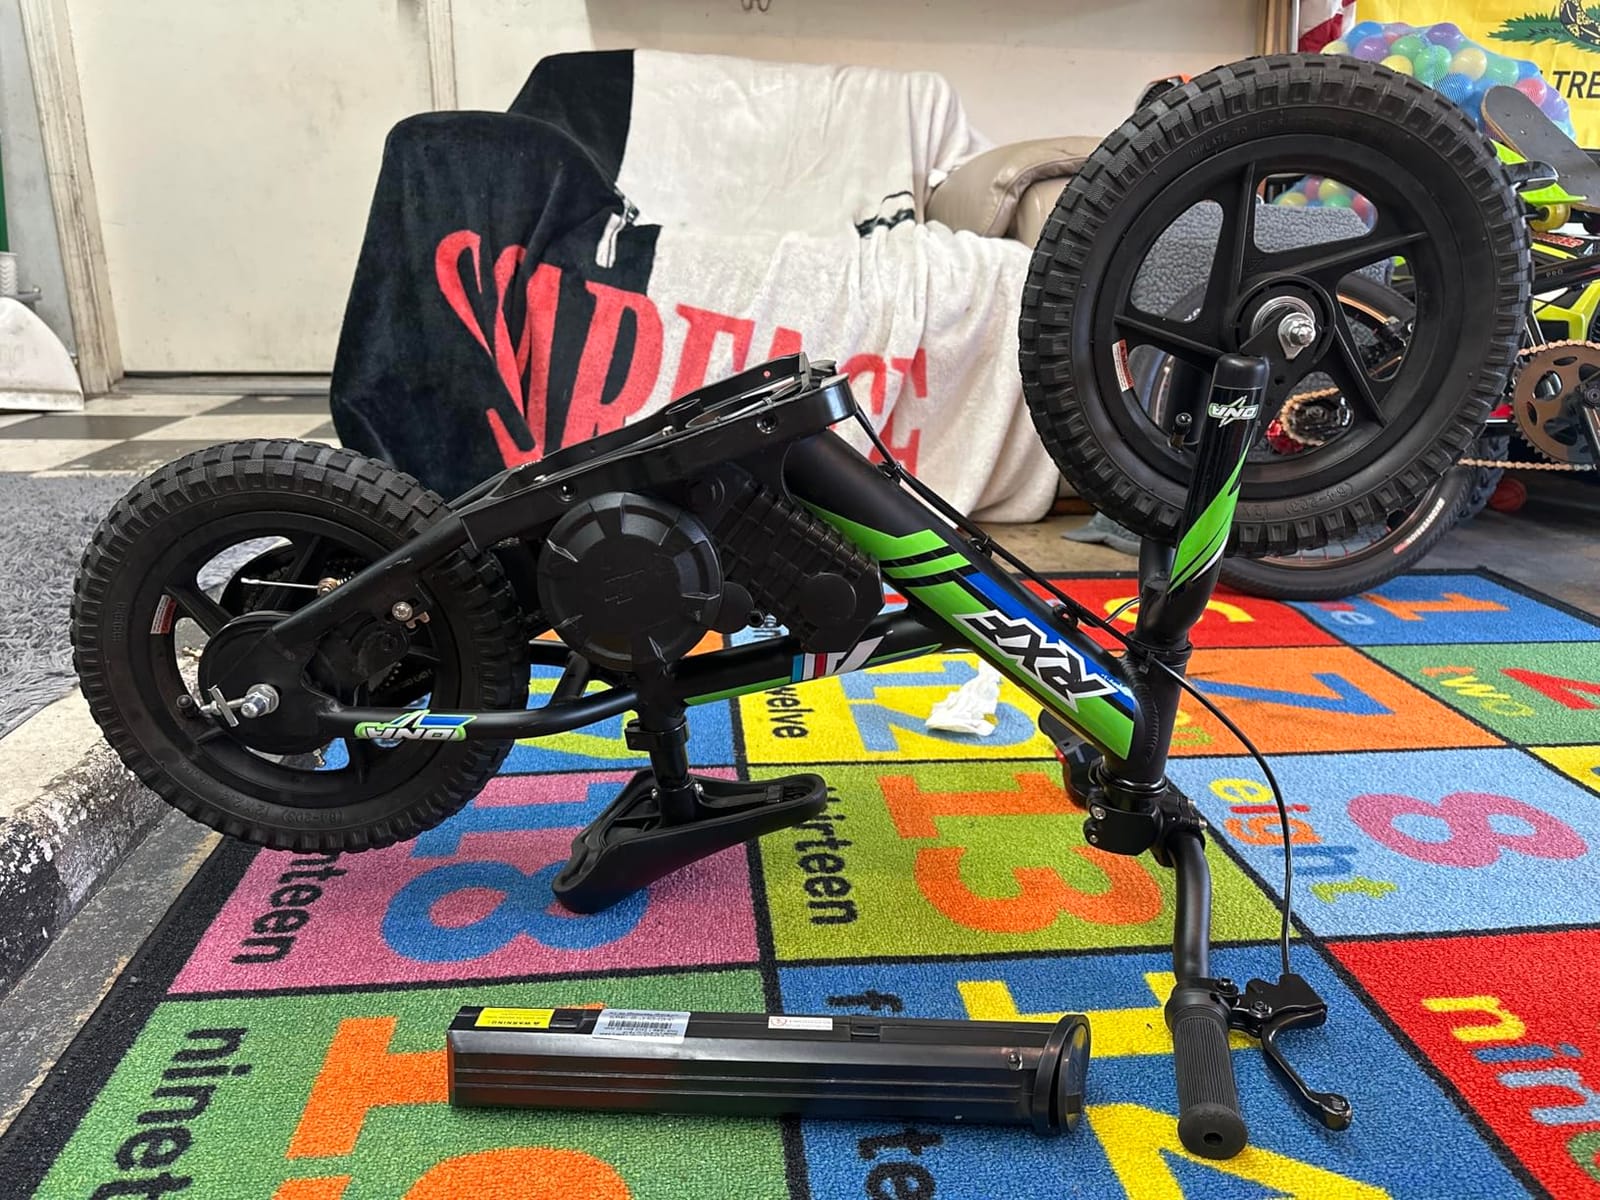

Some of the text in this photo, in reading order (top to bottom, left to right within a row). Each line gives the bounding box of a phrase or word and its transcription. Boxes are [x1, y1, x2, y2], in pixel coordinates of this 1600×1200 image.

[1210, 403, 1259, 420] DNA
[952, 608, 1119, 713] RXF
[1419, 664, 1537, 717] two
[360, 724, 462, 741] DNA
[877, 771, 1164, 935] 13
[1207, 777, 1398, 904] eight
[1346, 791, 1590, 870] 8
